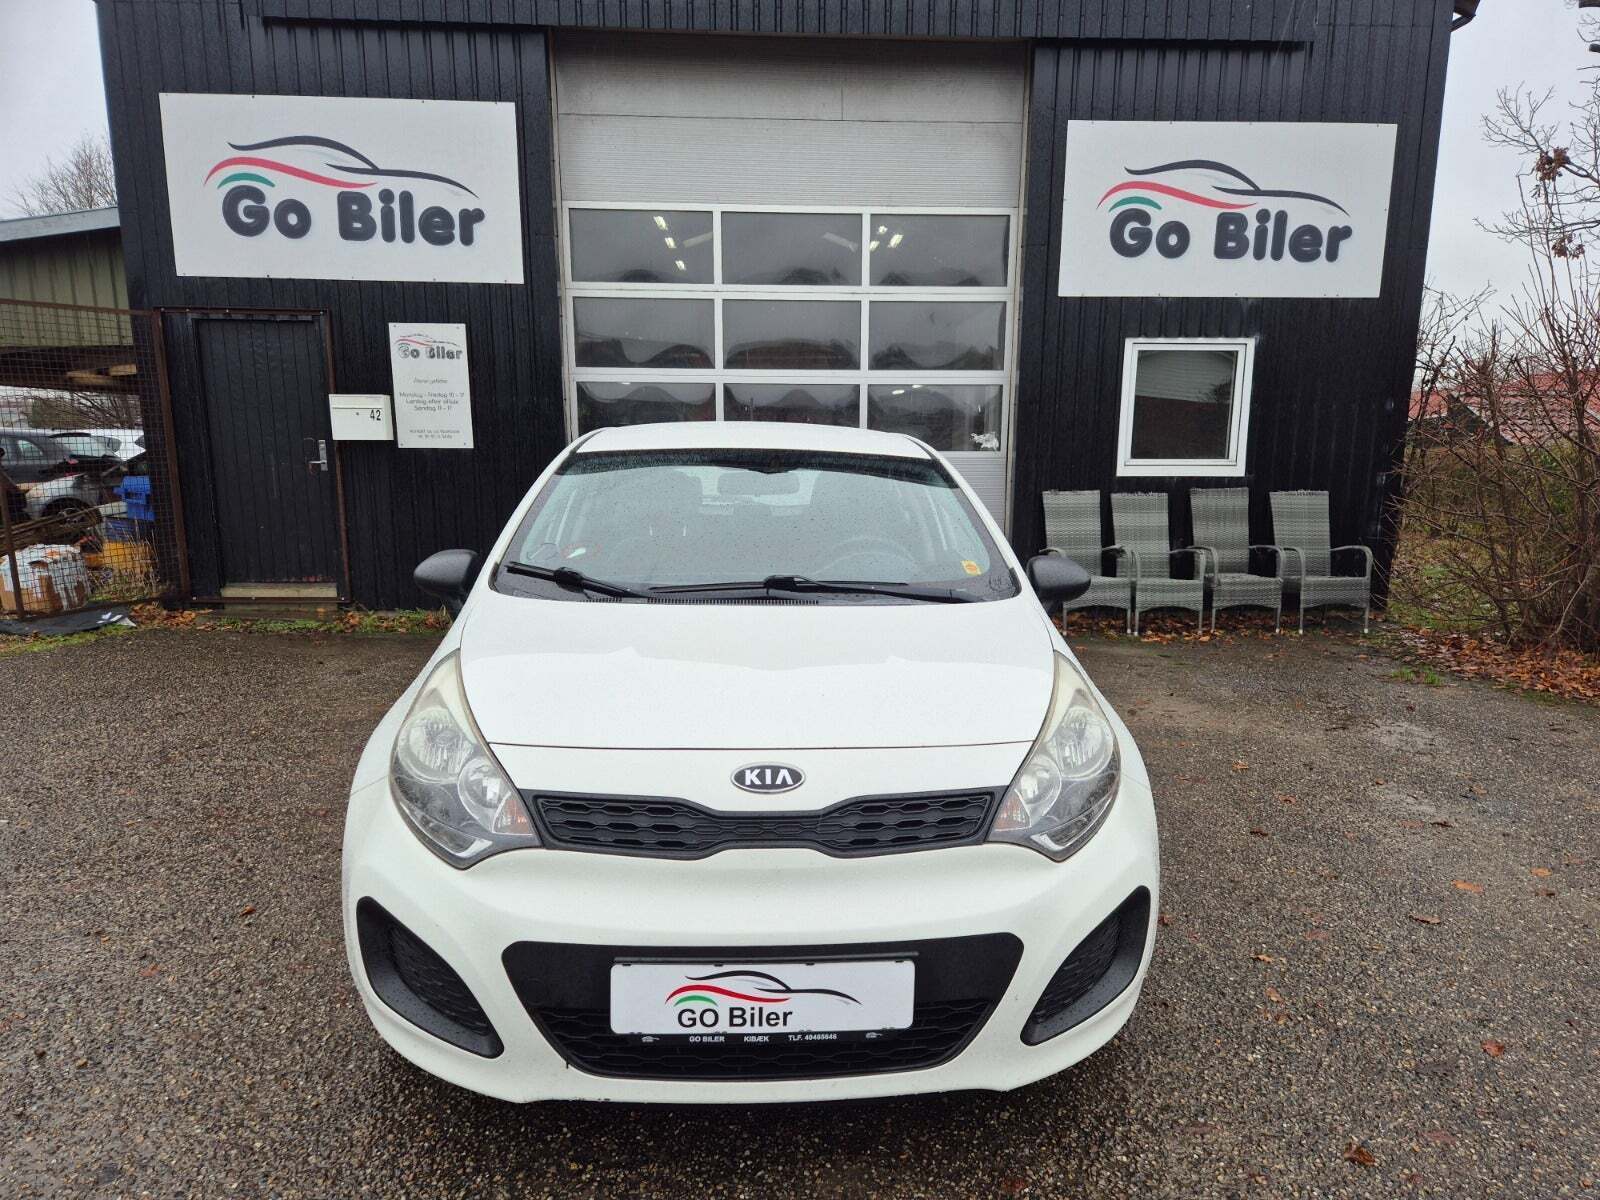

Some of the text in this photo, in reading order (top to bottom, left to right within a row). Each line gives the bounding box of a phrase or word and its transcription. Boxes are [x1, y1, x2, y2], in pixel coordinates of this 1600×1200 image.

[222, 185, 485, 246] Go Biler
[1109, 207, 1353, 263] Go Biler
[398, 344, 462, 360] Go Biler
[370, 409, 381, 421] 42
[744, 768, 794, 786] KIA
[677, 1006, 793, 1028] GO Biler
[689, 1035, 701, 1043] GO
[702, 1035, 725, 1043] BILER
